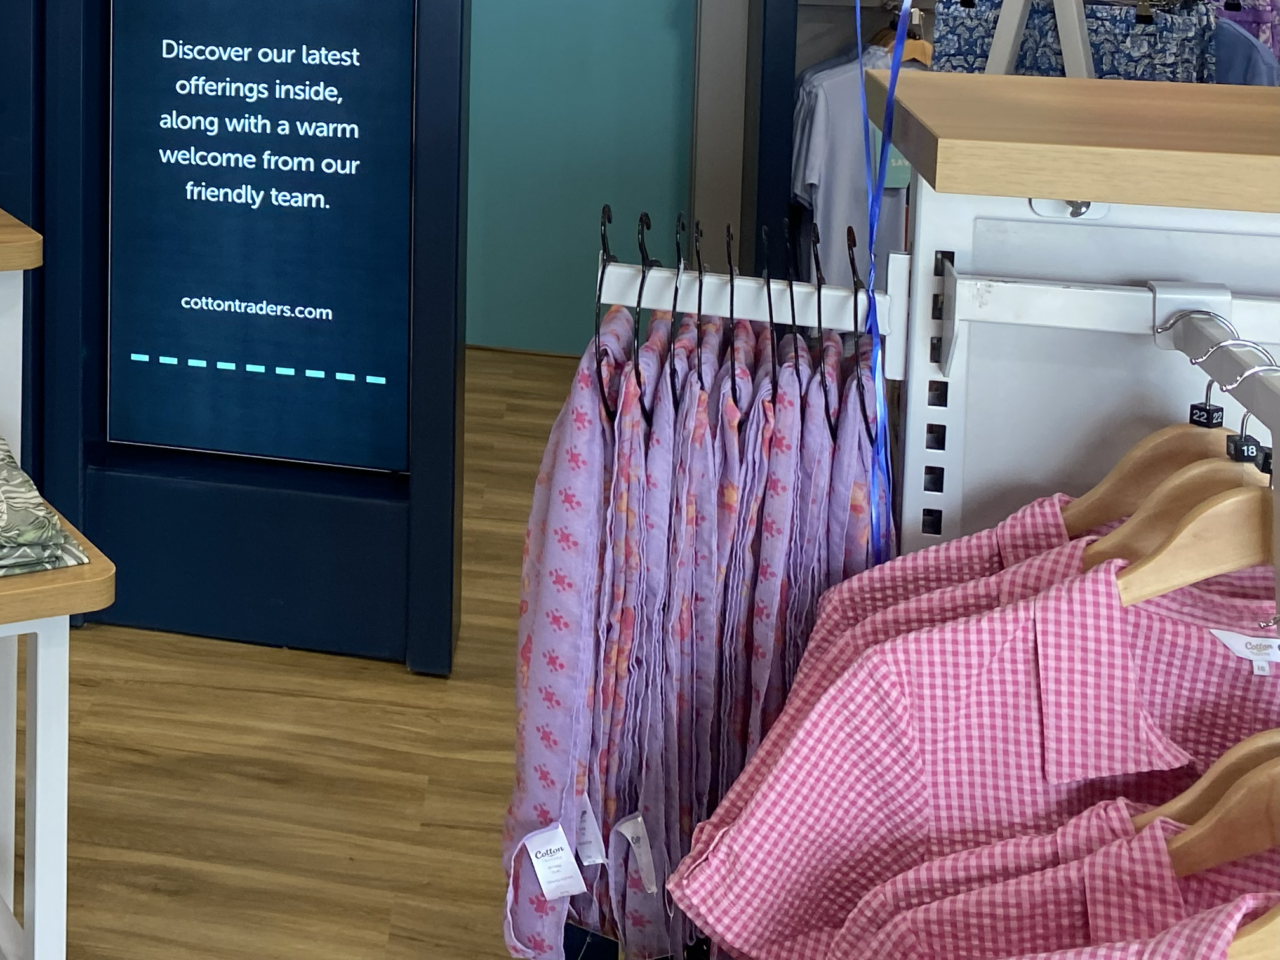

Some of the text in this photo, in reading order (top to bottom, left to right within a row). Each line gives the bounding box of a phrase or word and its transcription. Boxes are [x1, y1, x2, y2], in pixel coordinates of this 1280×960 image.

[163, 40, 360, 66] Discover our latest
[176, 76, 342, 104] offerings inside,
[160, 110, 358, 138] along with a warm
[159, 147, 360, 174] welcome from our
[186, 181, 329, 209] friendly team.
[181, 297, 332, 320] cottontraders.com
[1192, 410, 1207, 423] 22
[1212, 412, 1222, 423] 22
[1241, 445, 1257, 456] 18
[1245, 641, 1273, 651] Cotton
[535, 846, 564, 860] Cotton
